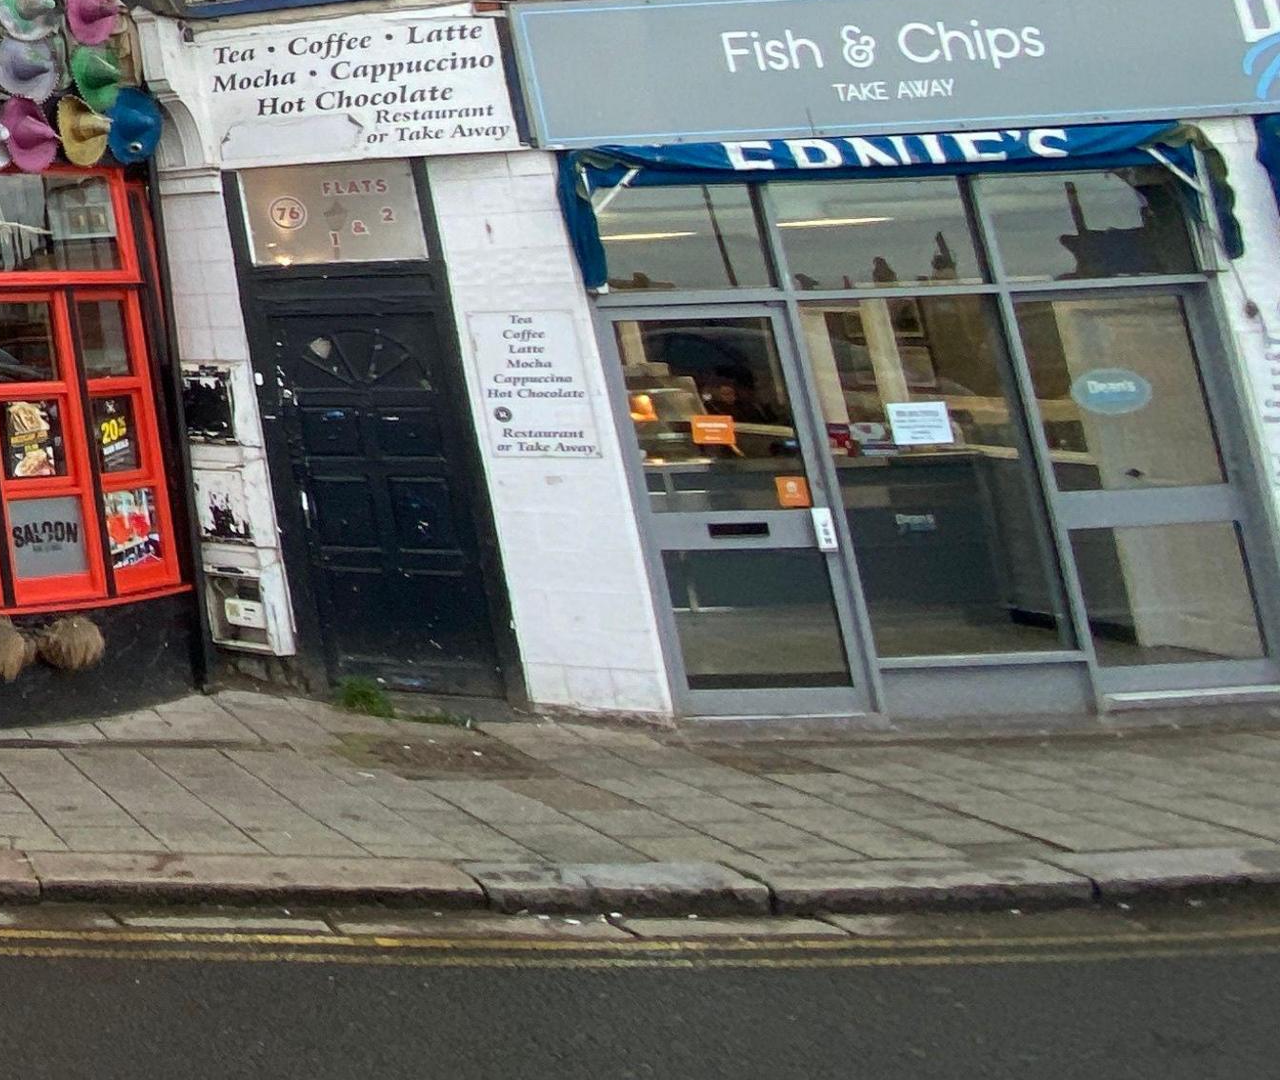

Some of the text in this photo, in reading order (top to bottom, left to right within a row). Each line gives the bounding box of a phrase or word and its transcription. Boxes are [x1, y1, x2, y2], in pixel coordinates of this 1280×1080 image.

[214, 24, 483, 65] Tea Coffee Latte
[720, 19, 1045, 72] Fish & Chips
[212, 53, 495, 93] Mocha Cappuccino
[832, 78, 955, 102] TAKE AWAY
[257, 85, 453, 117] Hot Chocolate
[375, 104, 495, 124] Restaurant
[366, 123, 510, 145] or Take Away
[321, 180, 388, 195] FLATS
[276, 206, 301, 221] 76
[331, 208, 394, 246] 1 & 2
[509, 314, 533, 324] Tea
[502, 329, 545, 342] Coffee
[508, 344, 545, 354] Latte
[506, 358, 552, 368] Mocha
[493, 373, 573, 386] Cappuccino
[487, 388, 585, 398] Hot Chocolate
[502, 428, 585, 438] Restaurant
[497, 441, 596, 454] or Take Away
[12, 521, 78, 548] SALOON
